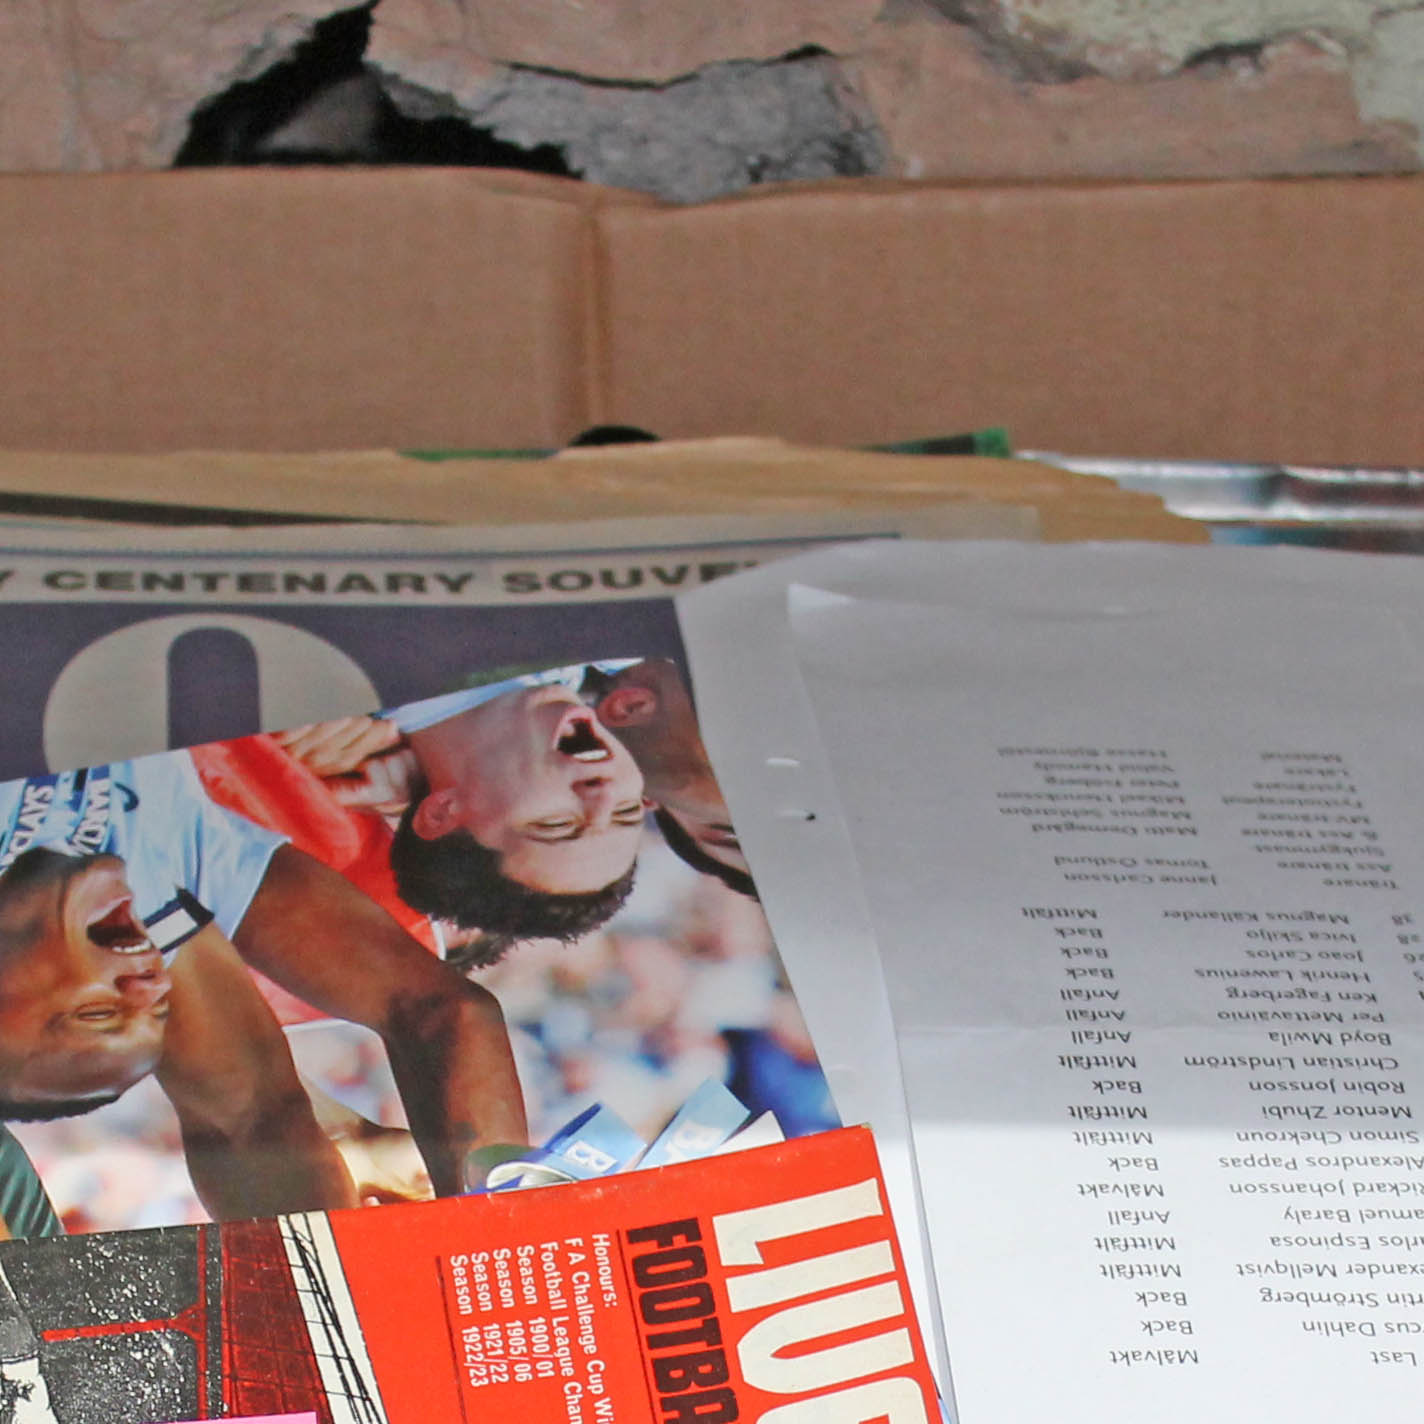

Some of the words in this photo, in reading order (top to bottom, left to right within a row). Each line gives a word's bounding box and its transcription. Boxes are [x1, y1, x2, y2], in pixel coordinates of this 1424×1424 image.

[41, 568, 475, 595] CENTENARY
[503, 560, 758, 595] SOUVE
[1092, 1081, 1142, 1095] Back
[1249, 1078, 1336, 1094] Jonsson
[1343, 1081, 1405, 1096] Robin
[1077, 1184, 1164, 1199] Målvakt
[1229, 1179, 1345, 1198] Johansson
[1108, 1210, 1170, 1225] Anfall
[1284, 1206, 1351, 1224] Baraly
[564, 1237, 583, 1247] F
[1094, 1237, 1176, 1252] Mittfält
[1269, 1232, 1371, 1250] Espinosa
[568, 1252, 586, 1265] A
[540, 1241, 568, 1311] Football
[592, 1233, 617, 1308] Honours:
[1099, 1264, 1182, 1280] Mittfält
[1236, 1259, 1337, 1279] Mellqvist
[1135, 1292, 1188, 1307] Back
[1259, 1287, 1379, 1308] Strömberg
[471, 1251, 493, 1312] Season
[483, 1323, 510, 1384] 1921/22
[492, 1248, 515, 1309] Season
[505, 1320, 533, 1382] 1905/06
[517, 1245, 538, 1305] Season
[528, 1316, 555, 1378] 1900/01
[571, 1271, 598, 1355] Challenge
[450, 1254, 473, 1316] Season
[462, 1326, 490, 1388] 1922/23
[1140, 1320, 1193, 1336] Back
[1302, 1321, 1376, 1337] Dahlin
[551, 1316, 575, 1377] League
[1109, 1350, 1199, 1367] Målvakt
[1370, 1351, 1417, 1367] Last
[586, 1360, 606, 1395] Cup
